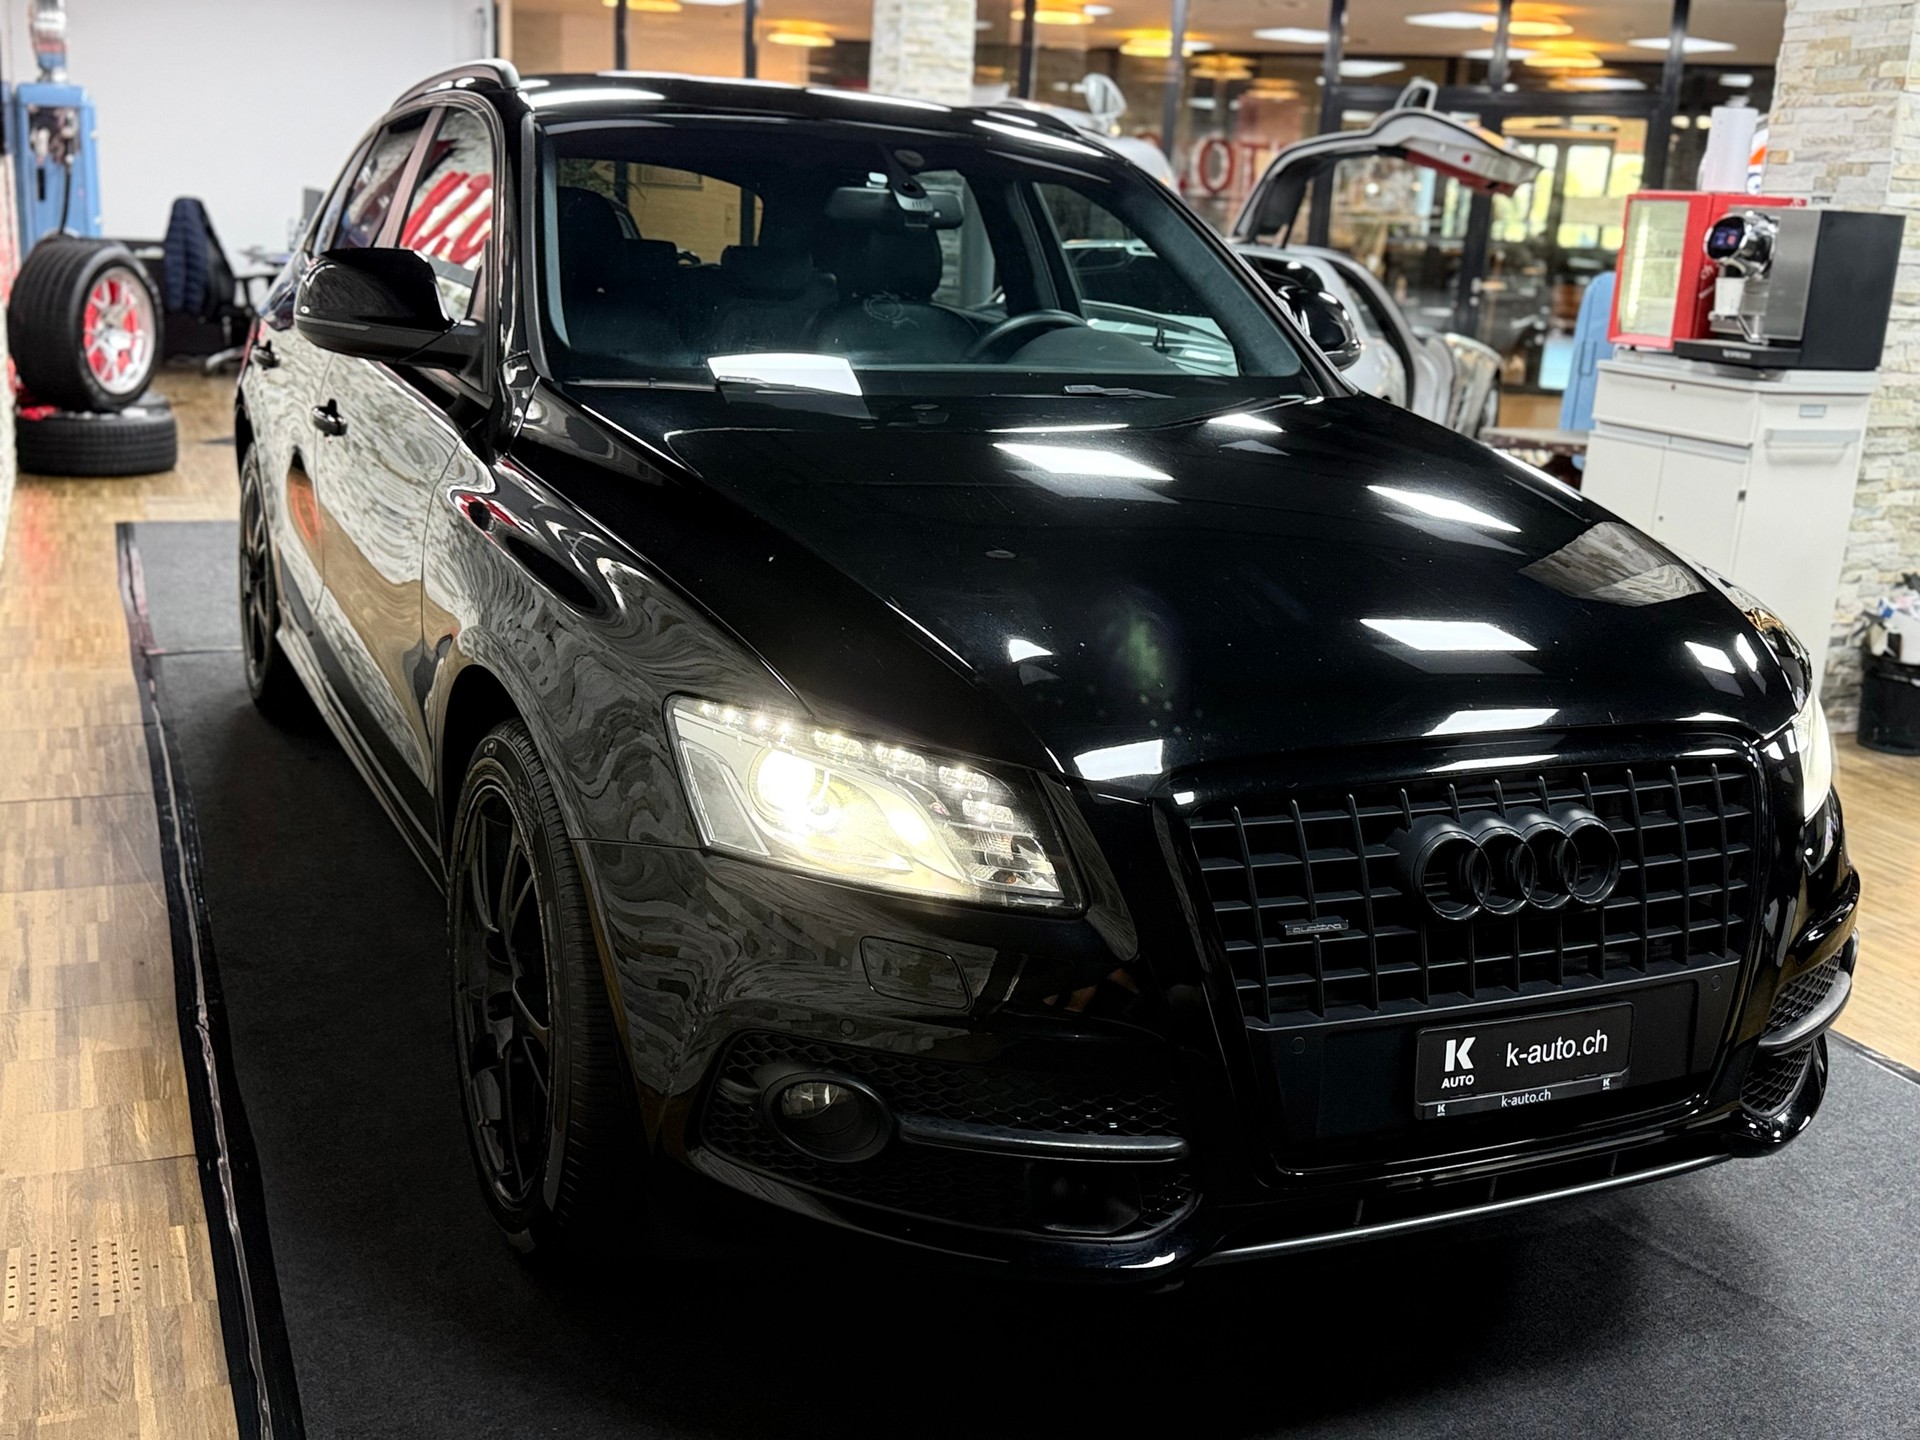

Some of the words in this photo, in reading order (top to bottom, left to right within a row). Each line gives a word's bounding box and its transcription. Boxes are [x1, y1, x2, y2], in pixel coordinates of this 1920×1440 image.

[1444, 1036, 1476, 1072] K
[1506, 1029, 1608, 1067] k-auto.ch
[1441, 1074, 1475, 1089] AUTO
[1501, 1089, 1551, 1107] k-auto.ch
